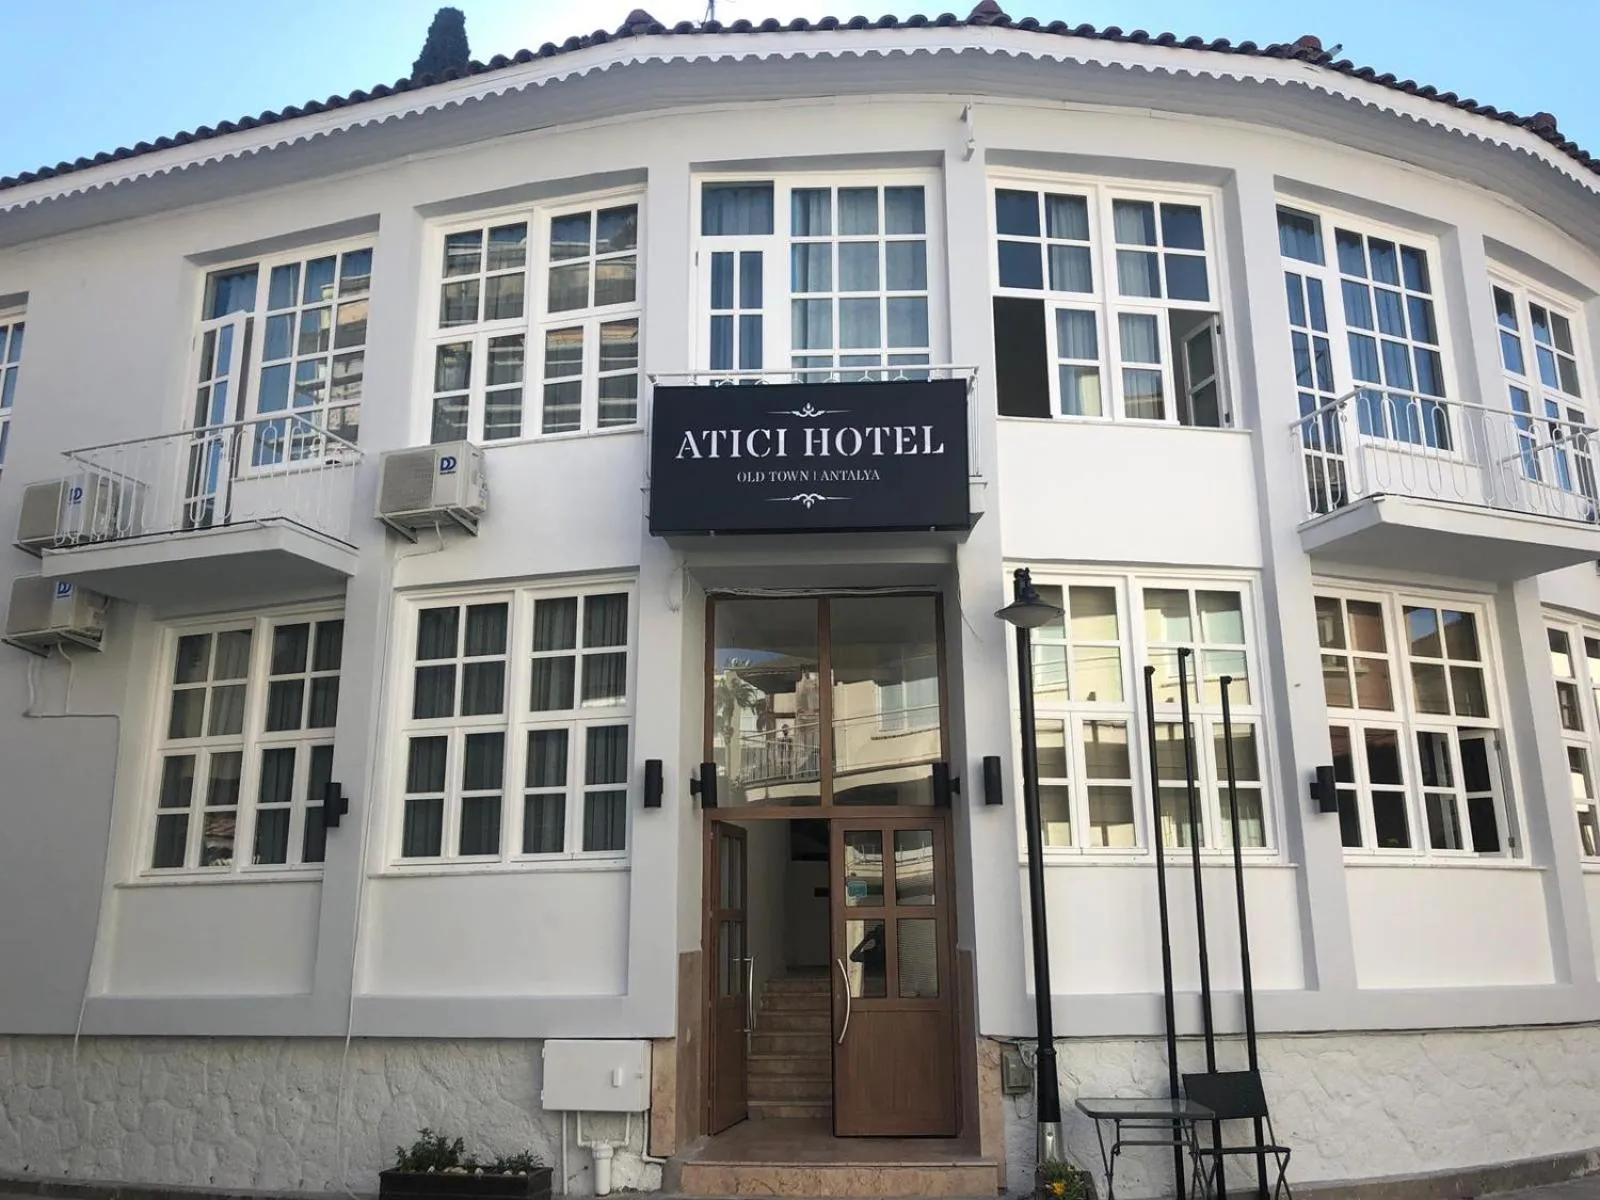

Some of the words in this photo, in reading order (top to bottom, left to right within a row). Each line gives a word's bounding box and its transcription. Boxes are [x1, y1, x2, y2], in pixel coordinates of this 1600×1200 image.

[675, 428, 788, 459] ATICI
[803, 425, 945, 457] HOTEL
[736, 471, 765, 483] OLD
[768, 470, 809, 482] TOWN
[820, 469, 881, 481] ANTALYA
